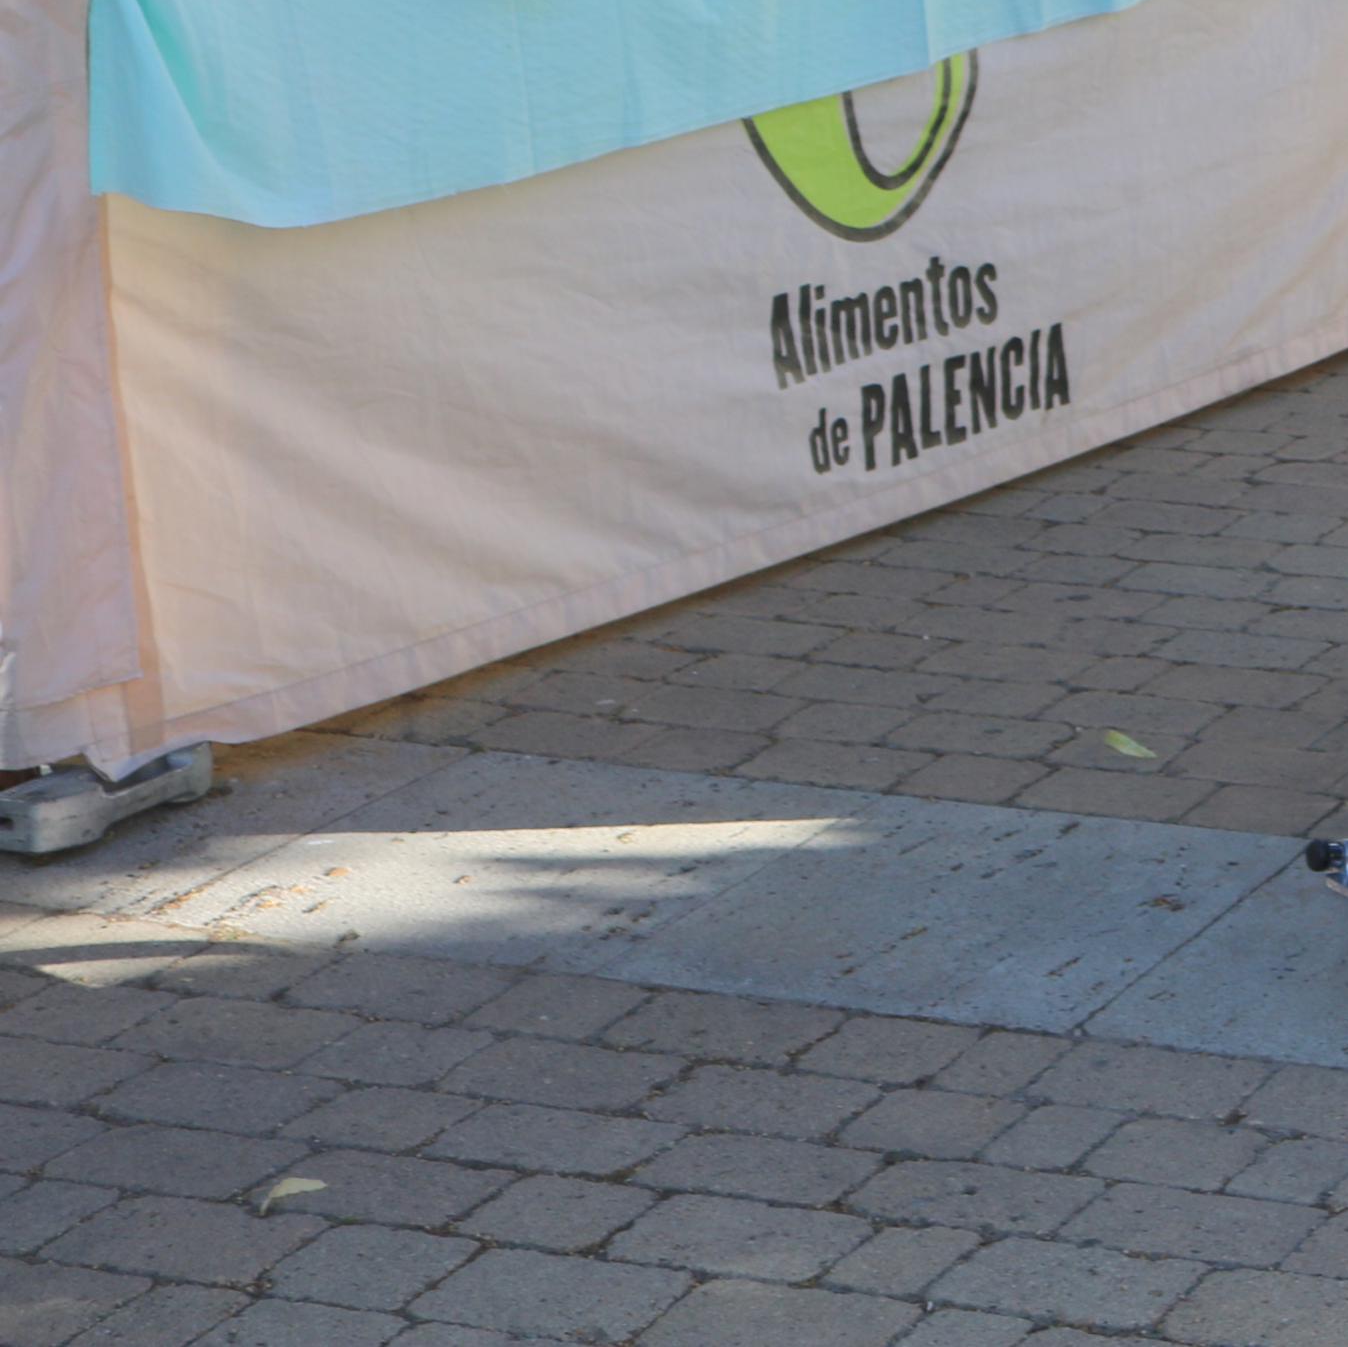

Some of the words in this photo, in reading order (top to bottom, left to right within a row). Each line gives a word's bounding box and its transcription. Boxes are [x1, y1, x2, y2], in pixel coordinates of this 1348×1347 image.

[770, 256, 998, 389] Alimentos
[810, 408, 850, 475] de
[861, 323, 1071, 471] PALENCIA
